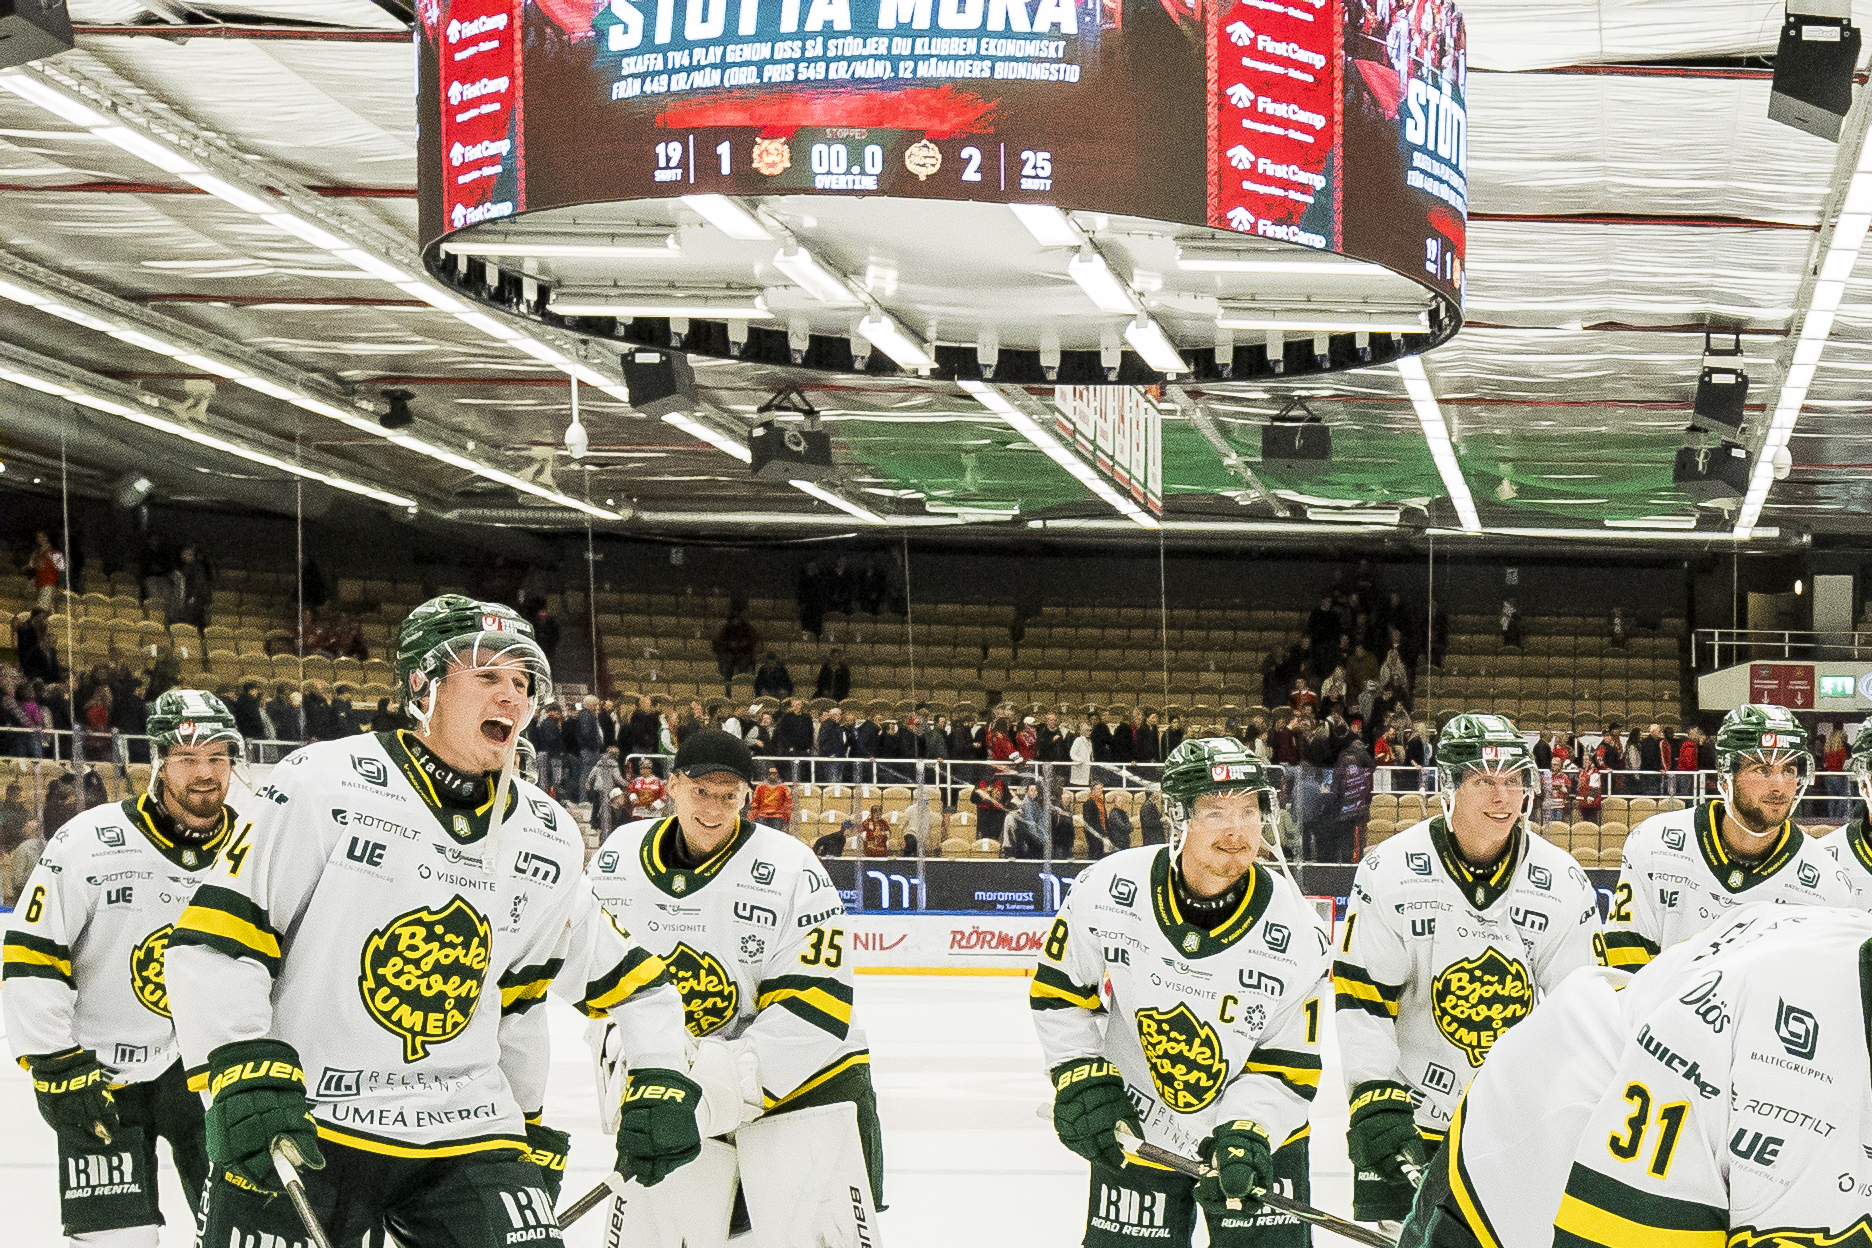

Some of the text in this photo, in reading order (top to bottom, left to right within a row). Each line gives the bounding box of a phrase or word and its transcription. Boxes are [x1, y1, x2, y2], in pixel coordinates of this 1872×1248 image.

[692, 46, 724, 66] PLAY
[774, 40, 802, 59] OSS
[891, 37, 912, 55] DU
[914, 37, 977, 55] KLUBBEN
[980, 38, 1066, 58] EKONOMISKT
[763, 63, 795, 82] PRIS
[797, 61, 827, 80] 549
[655, 141, 683, 168] 19
[716, 140, 731, 176] 1
[960, 145, 982, 182] 2
[1020, 150, 1052, 178] 25
[353, 812, 421, 842] ROTOTILT
[346, 836, 387, 869] UE
[436, 870, 496, 892] VISIONITE
[24, 885, 46, 923] 6
[661, 921, 707, 933] VISIONITE
[1044, 917, 1069, 962] 8
[799, 925, 844, 970] 35
[1164, 981, 1218, 1000] VISIONITE
[1679, 970, 1731, 1035] Diös
[374, 986, 466, 1035] UMEÅ
[1219, 994, 1239, 1024] C
[1303, 997, 1320, 1045] 1
[1636, 1023, 1720, 1099] Quicke
[1750, 1051, 1833, 1085] BALTICGRUPPEN
[1607, 1080, 1690, 1180] 31
[1743, 1098, 1836, 1138] ROTOTILT
[1730, 1127, 1784, 1167] UE
[506, 1227, 546, 1245] ROAD
[1091, 1216, 1170, 1239] ROAD RENTAL
